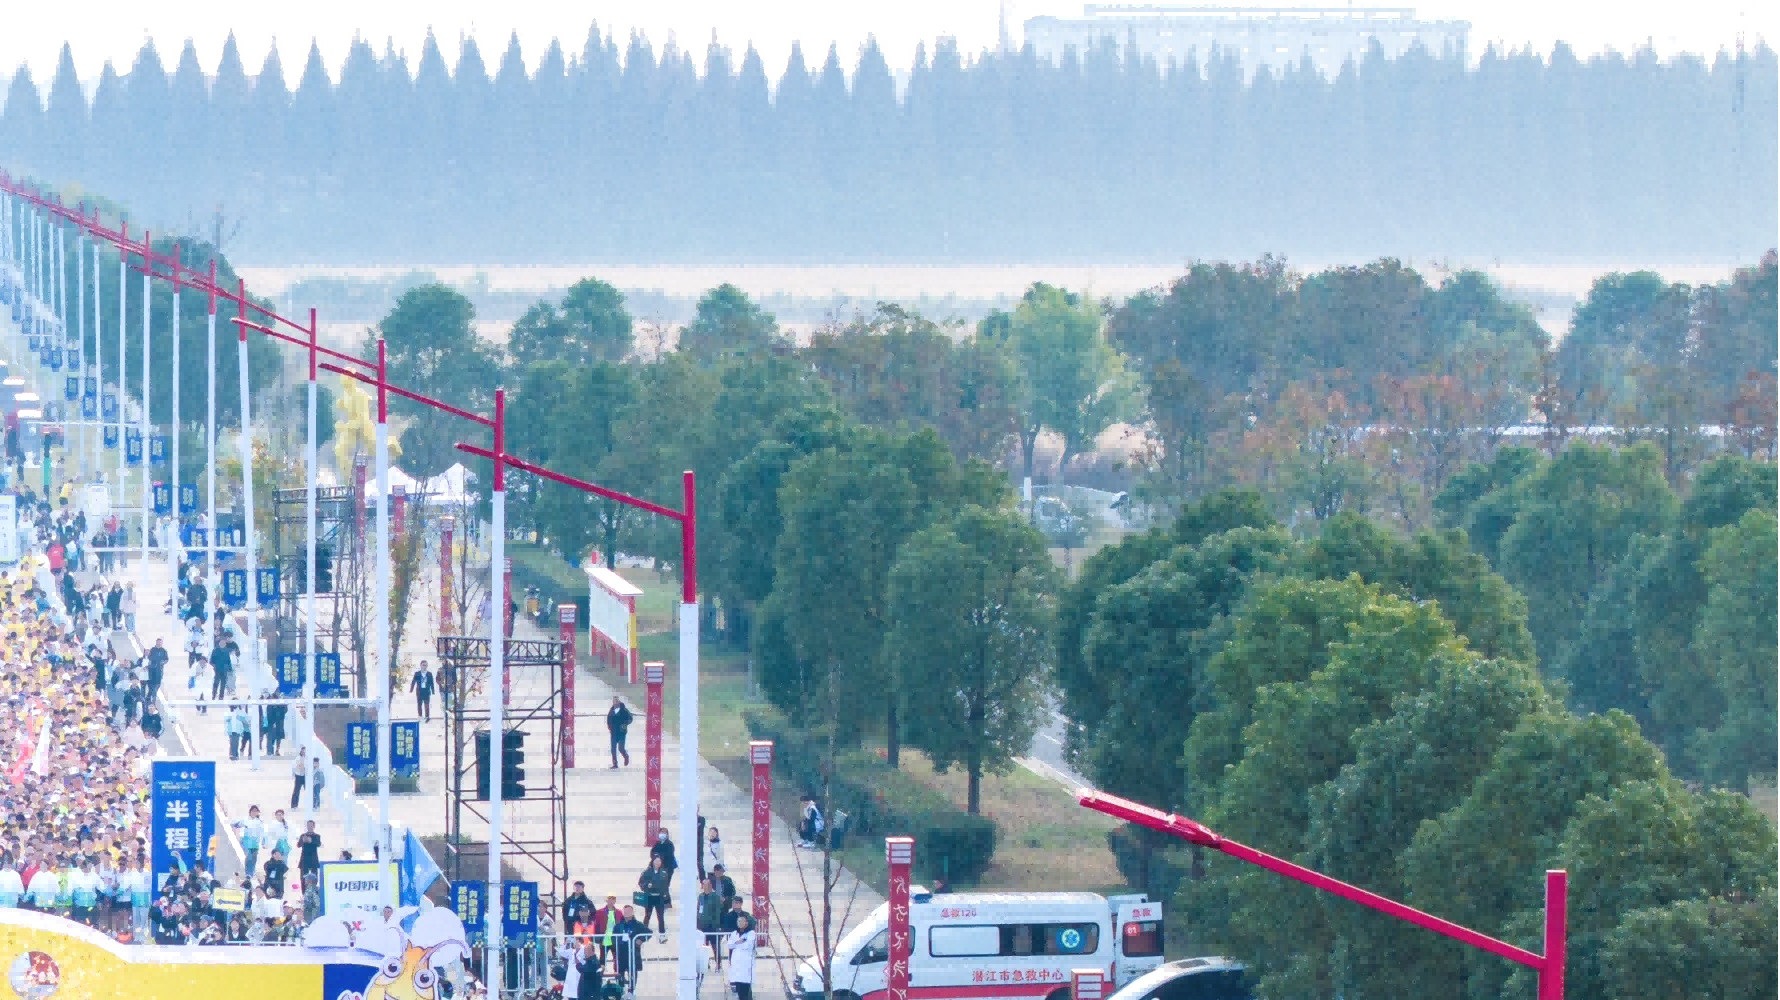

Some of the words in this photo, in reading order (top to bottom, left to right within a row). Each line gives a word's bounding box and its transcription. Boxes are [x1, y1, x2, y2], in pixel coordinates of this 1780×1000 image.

[165, 800, 190, 850] 半程
[195, 820, 203, 860] MARATHO
[972, 970, 1064, 982] 潜江市急救中心
